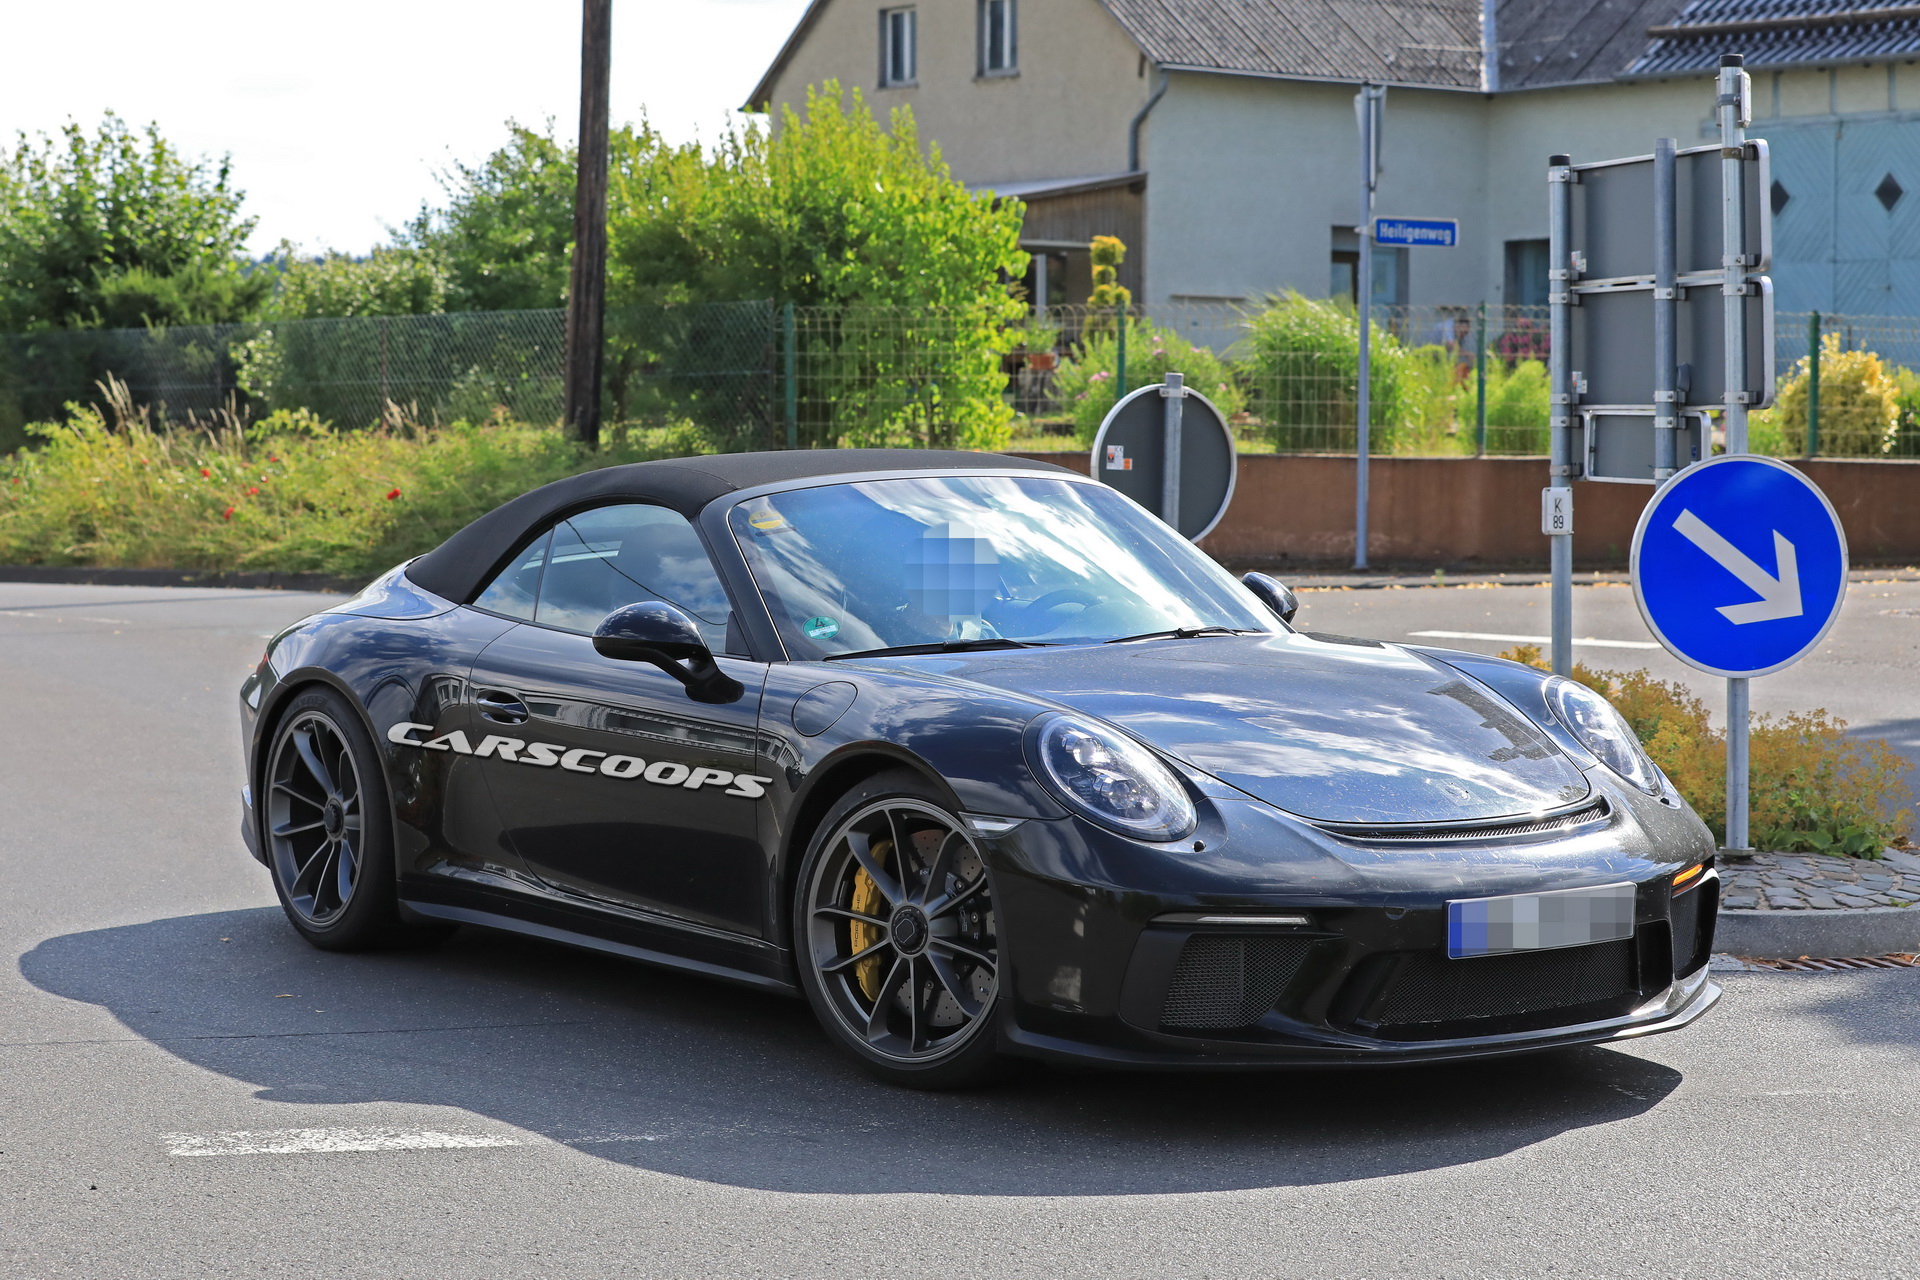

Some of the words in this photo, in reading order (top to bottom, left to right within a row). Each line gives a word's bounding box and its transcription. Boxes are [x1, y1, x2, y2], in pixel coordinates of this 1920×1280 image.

[1380, 222, 1452, 245] Heiligenweg
[1555, 498, 1562, 513] K
[1553, 515, 1564, 529] 89
[815, 617, 825, 627] 4
